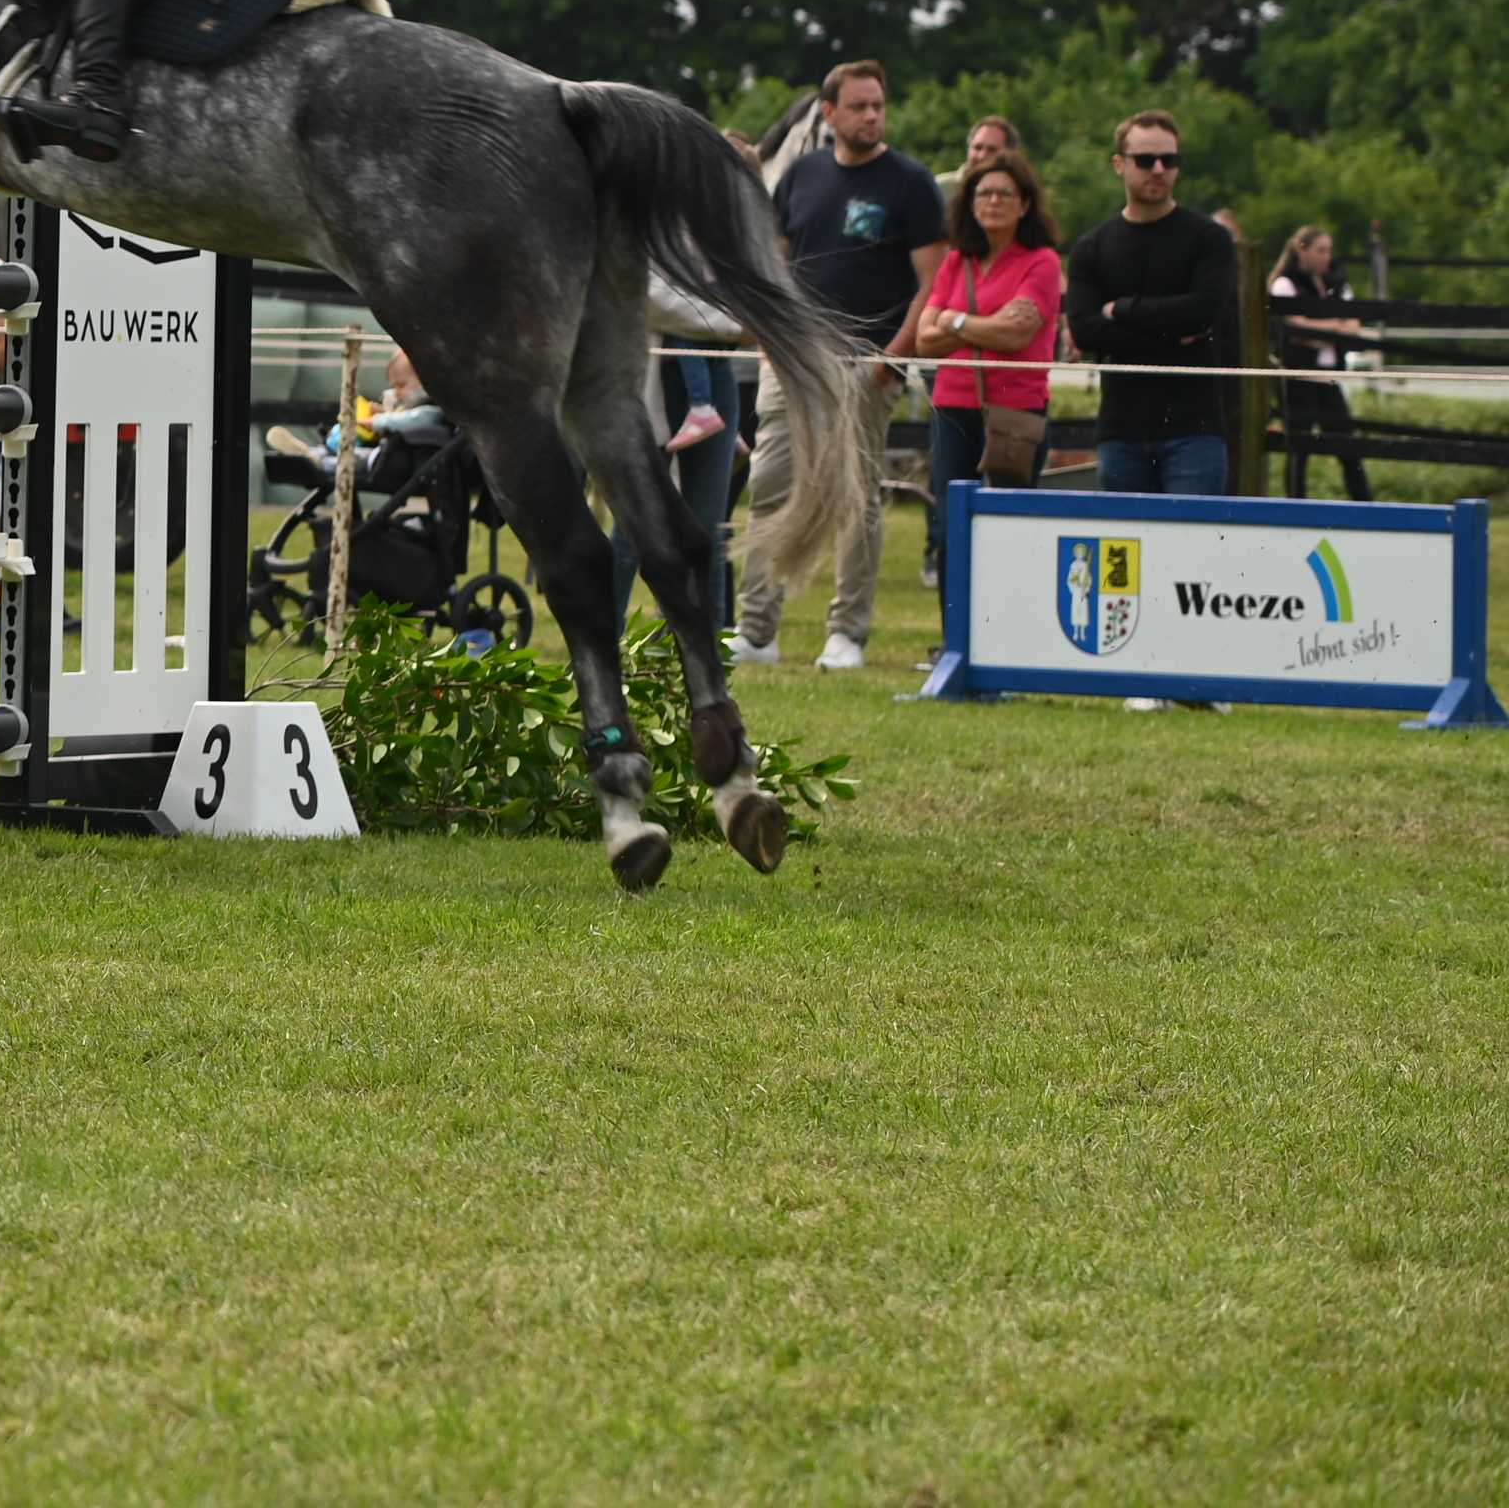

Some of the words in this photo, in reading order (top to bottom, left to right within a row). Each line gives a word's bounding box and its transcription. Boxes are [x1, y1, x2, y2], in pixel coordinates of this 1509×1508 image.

[1174, 581, 1305, 621] Weeze
[194, 723, 231, 820] 3
[284, 723, 319, 820] 3
